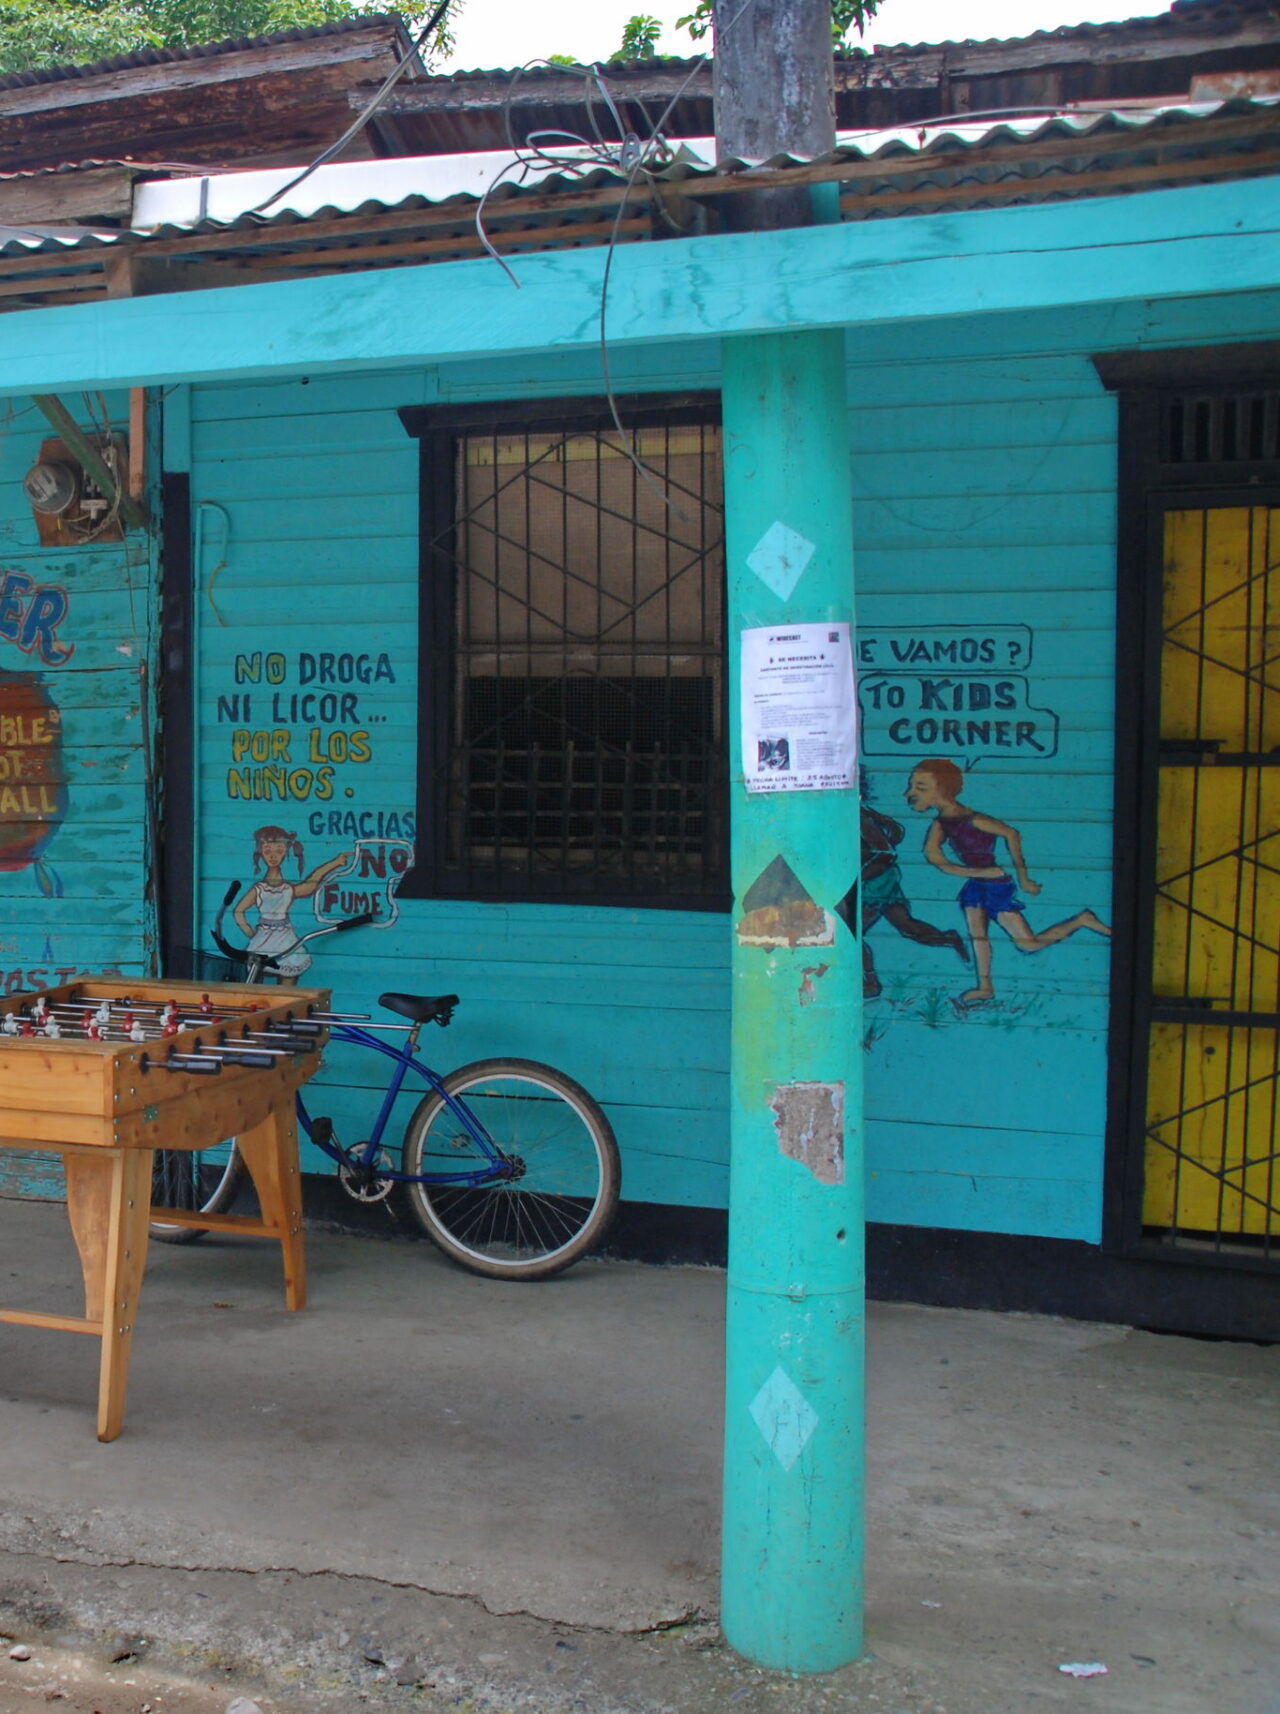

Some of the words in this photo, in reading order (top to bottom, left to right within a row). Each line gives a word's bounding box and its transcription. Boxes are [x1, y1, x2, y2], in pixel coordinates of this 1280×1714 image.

[234, 651, 287, 685] NO
[298, 652, 397, 685] DROGA
[217, 693, 251, 723] NI
[863, 680, 905, 710] TO
[917, 677, 1017, 712] KIDS
[232, 728, 293, 764] POR
[308, 727, 373, 764] LOS
[888, 717, 1046, 753] CORNER
[307, 809, 416, 840] GRACIAS
[358, 844, 410, 879] NO
[322, 883, 385, 917] FUME
